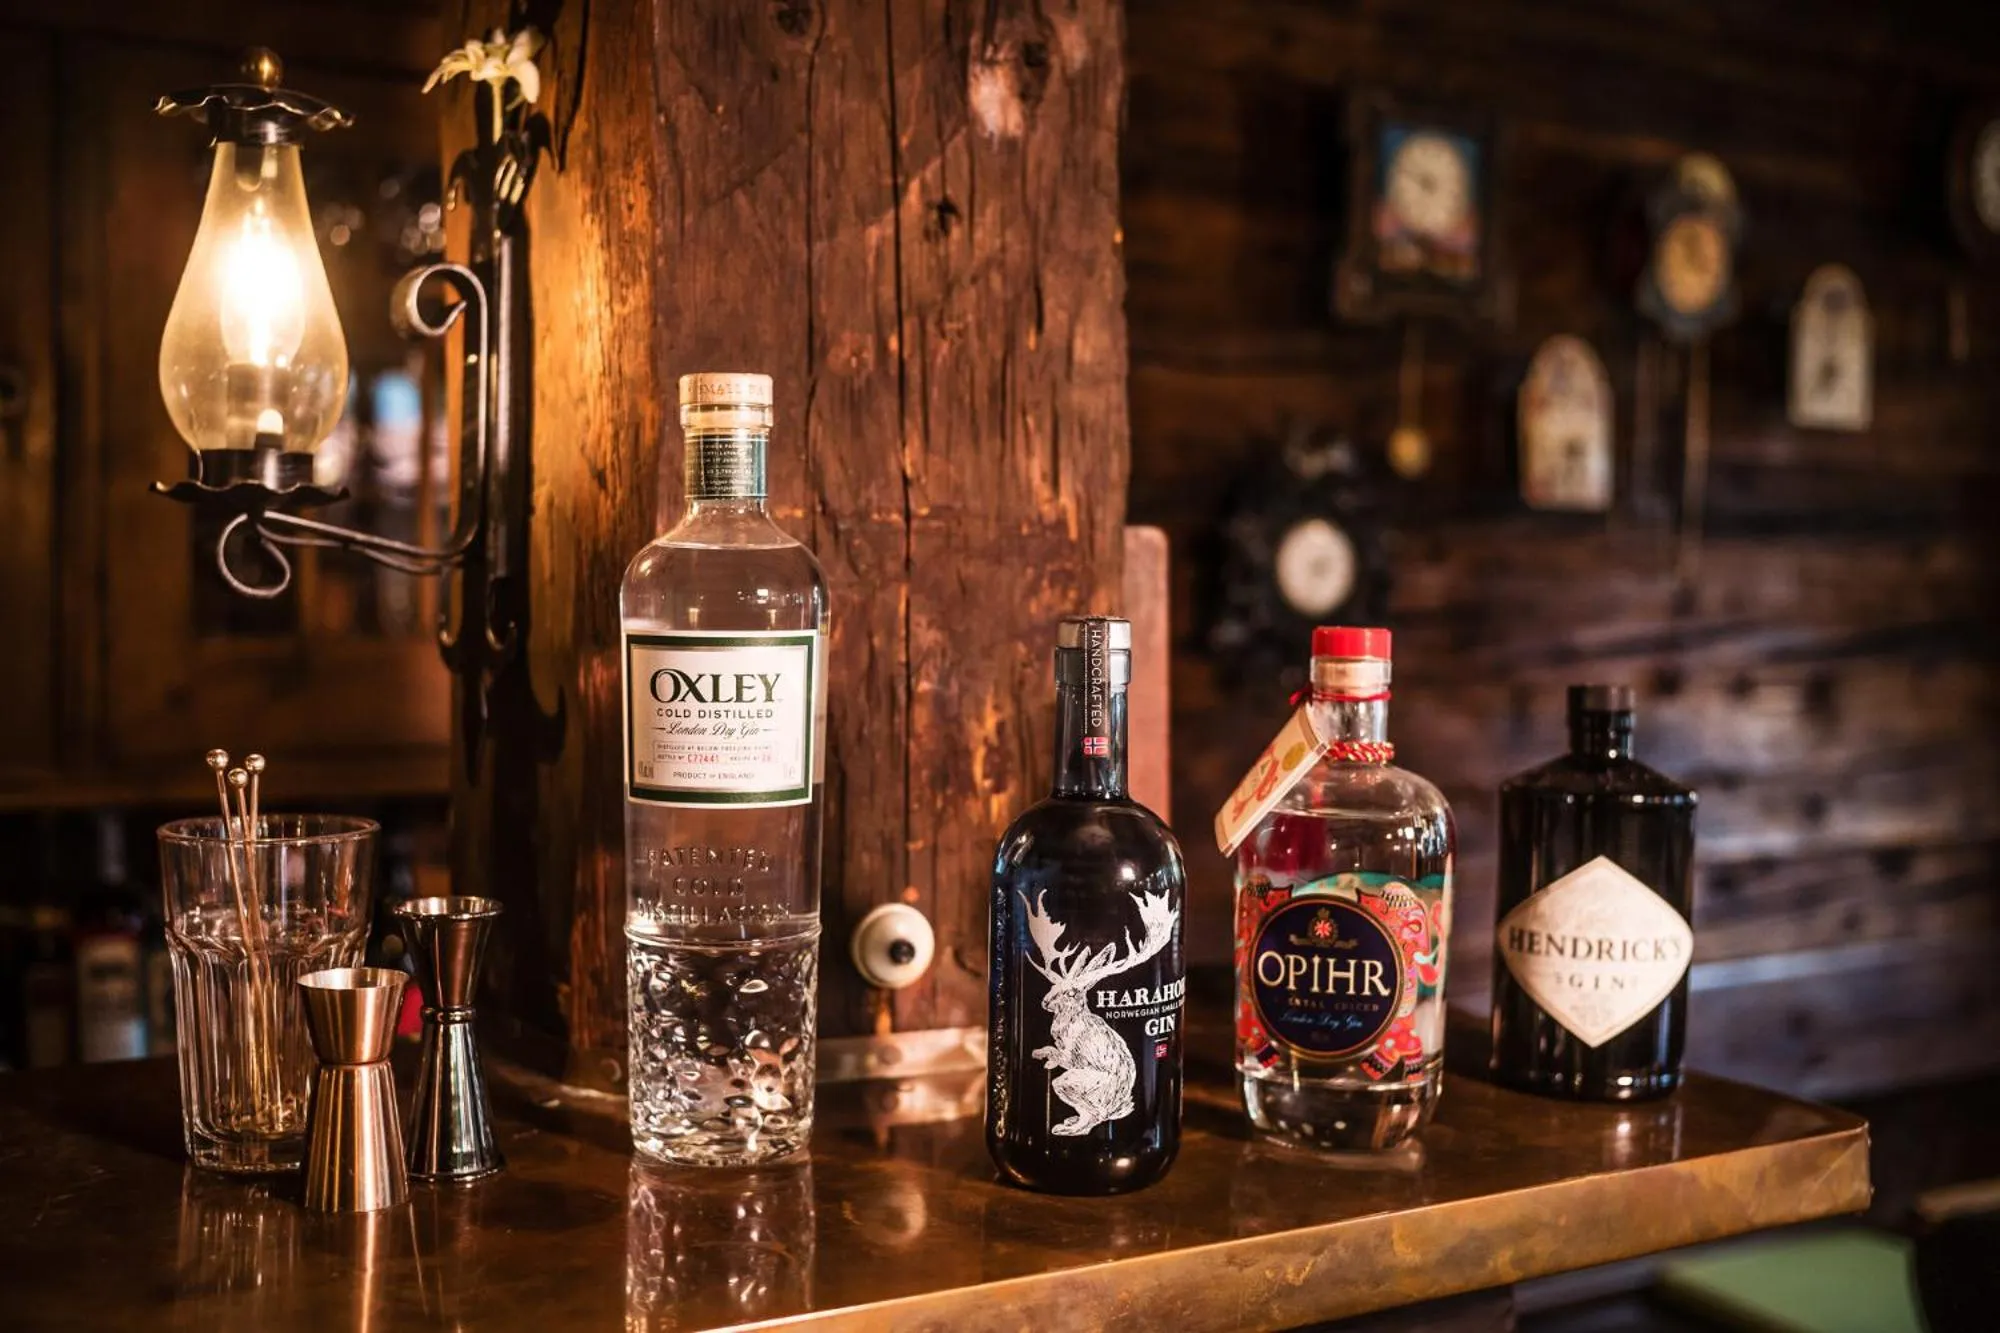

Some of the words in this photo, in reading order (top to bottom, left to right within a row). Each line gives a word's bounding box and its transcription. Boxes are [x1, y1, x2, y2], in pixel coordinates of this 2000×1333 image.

[650, 668, 781, 704] OXLEY
[1091, 629, 1102, 727] HANDCRAFTED
[656, 707, 692, 719] COLD
[697, 707, 773, 719] DISTILLED
[665, 721, 708, 736] London
[709, 722, 736, 741] Dry
[739, 722, 760, 740] Gin
[673, 771, 707, 779] PRODUCT
[648, 847, 775, 872] PATENTED
[673, 877, 745, 897] COLD
[1257, 950, 1391, 997] OPIHR
[1568, 972, 1625, 990] GIN
[1105, 1007, 1160, 1020] NORWEGIAN
[1144, 1013, 1176, 1037] GIN
